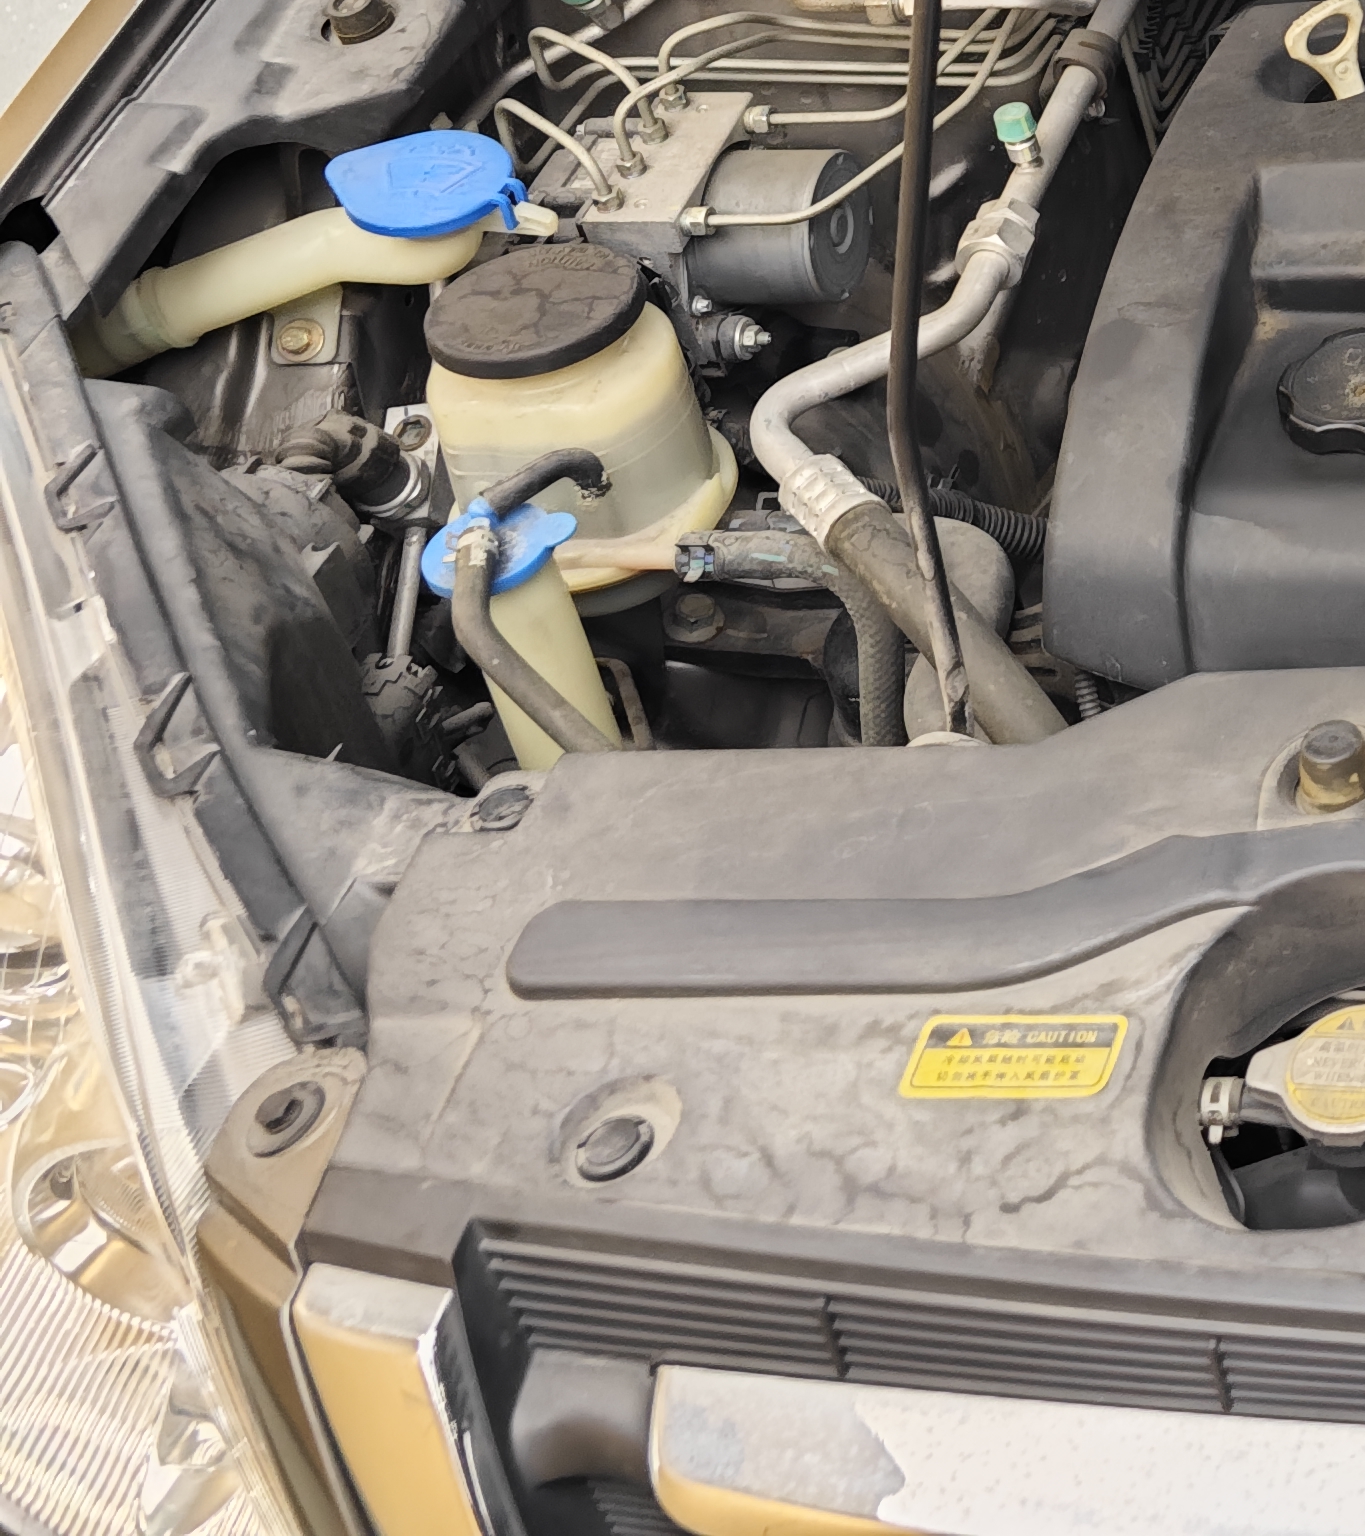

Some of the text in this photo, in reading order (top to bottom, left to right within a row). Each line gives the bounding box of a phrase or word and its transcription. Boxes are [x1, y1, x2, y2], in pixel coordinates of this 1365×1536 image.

[982, 1029, 1099, 1045] 危险 CAUTION
[1312, 1056, 1358, 1070] NEVER
[1314, 1070, 1352, 1083] WHEN
